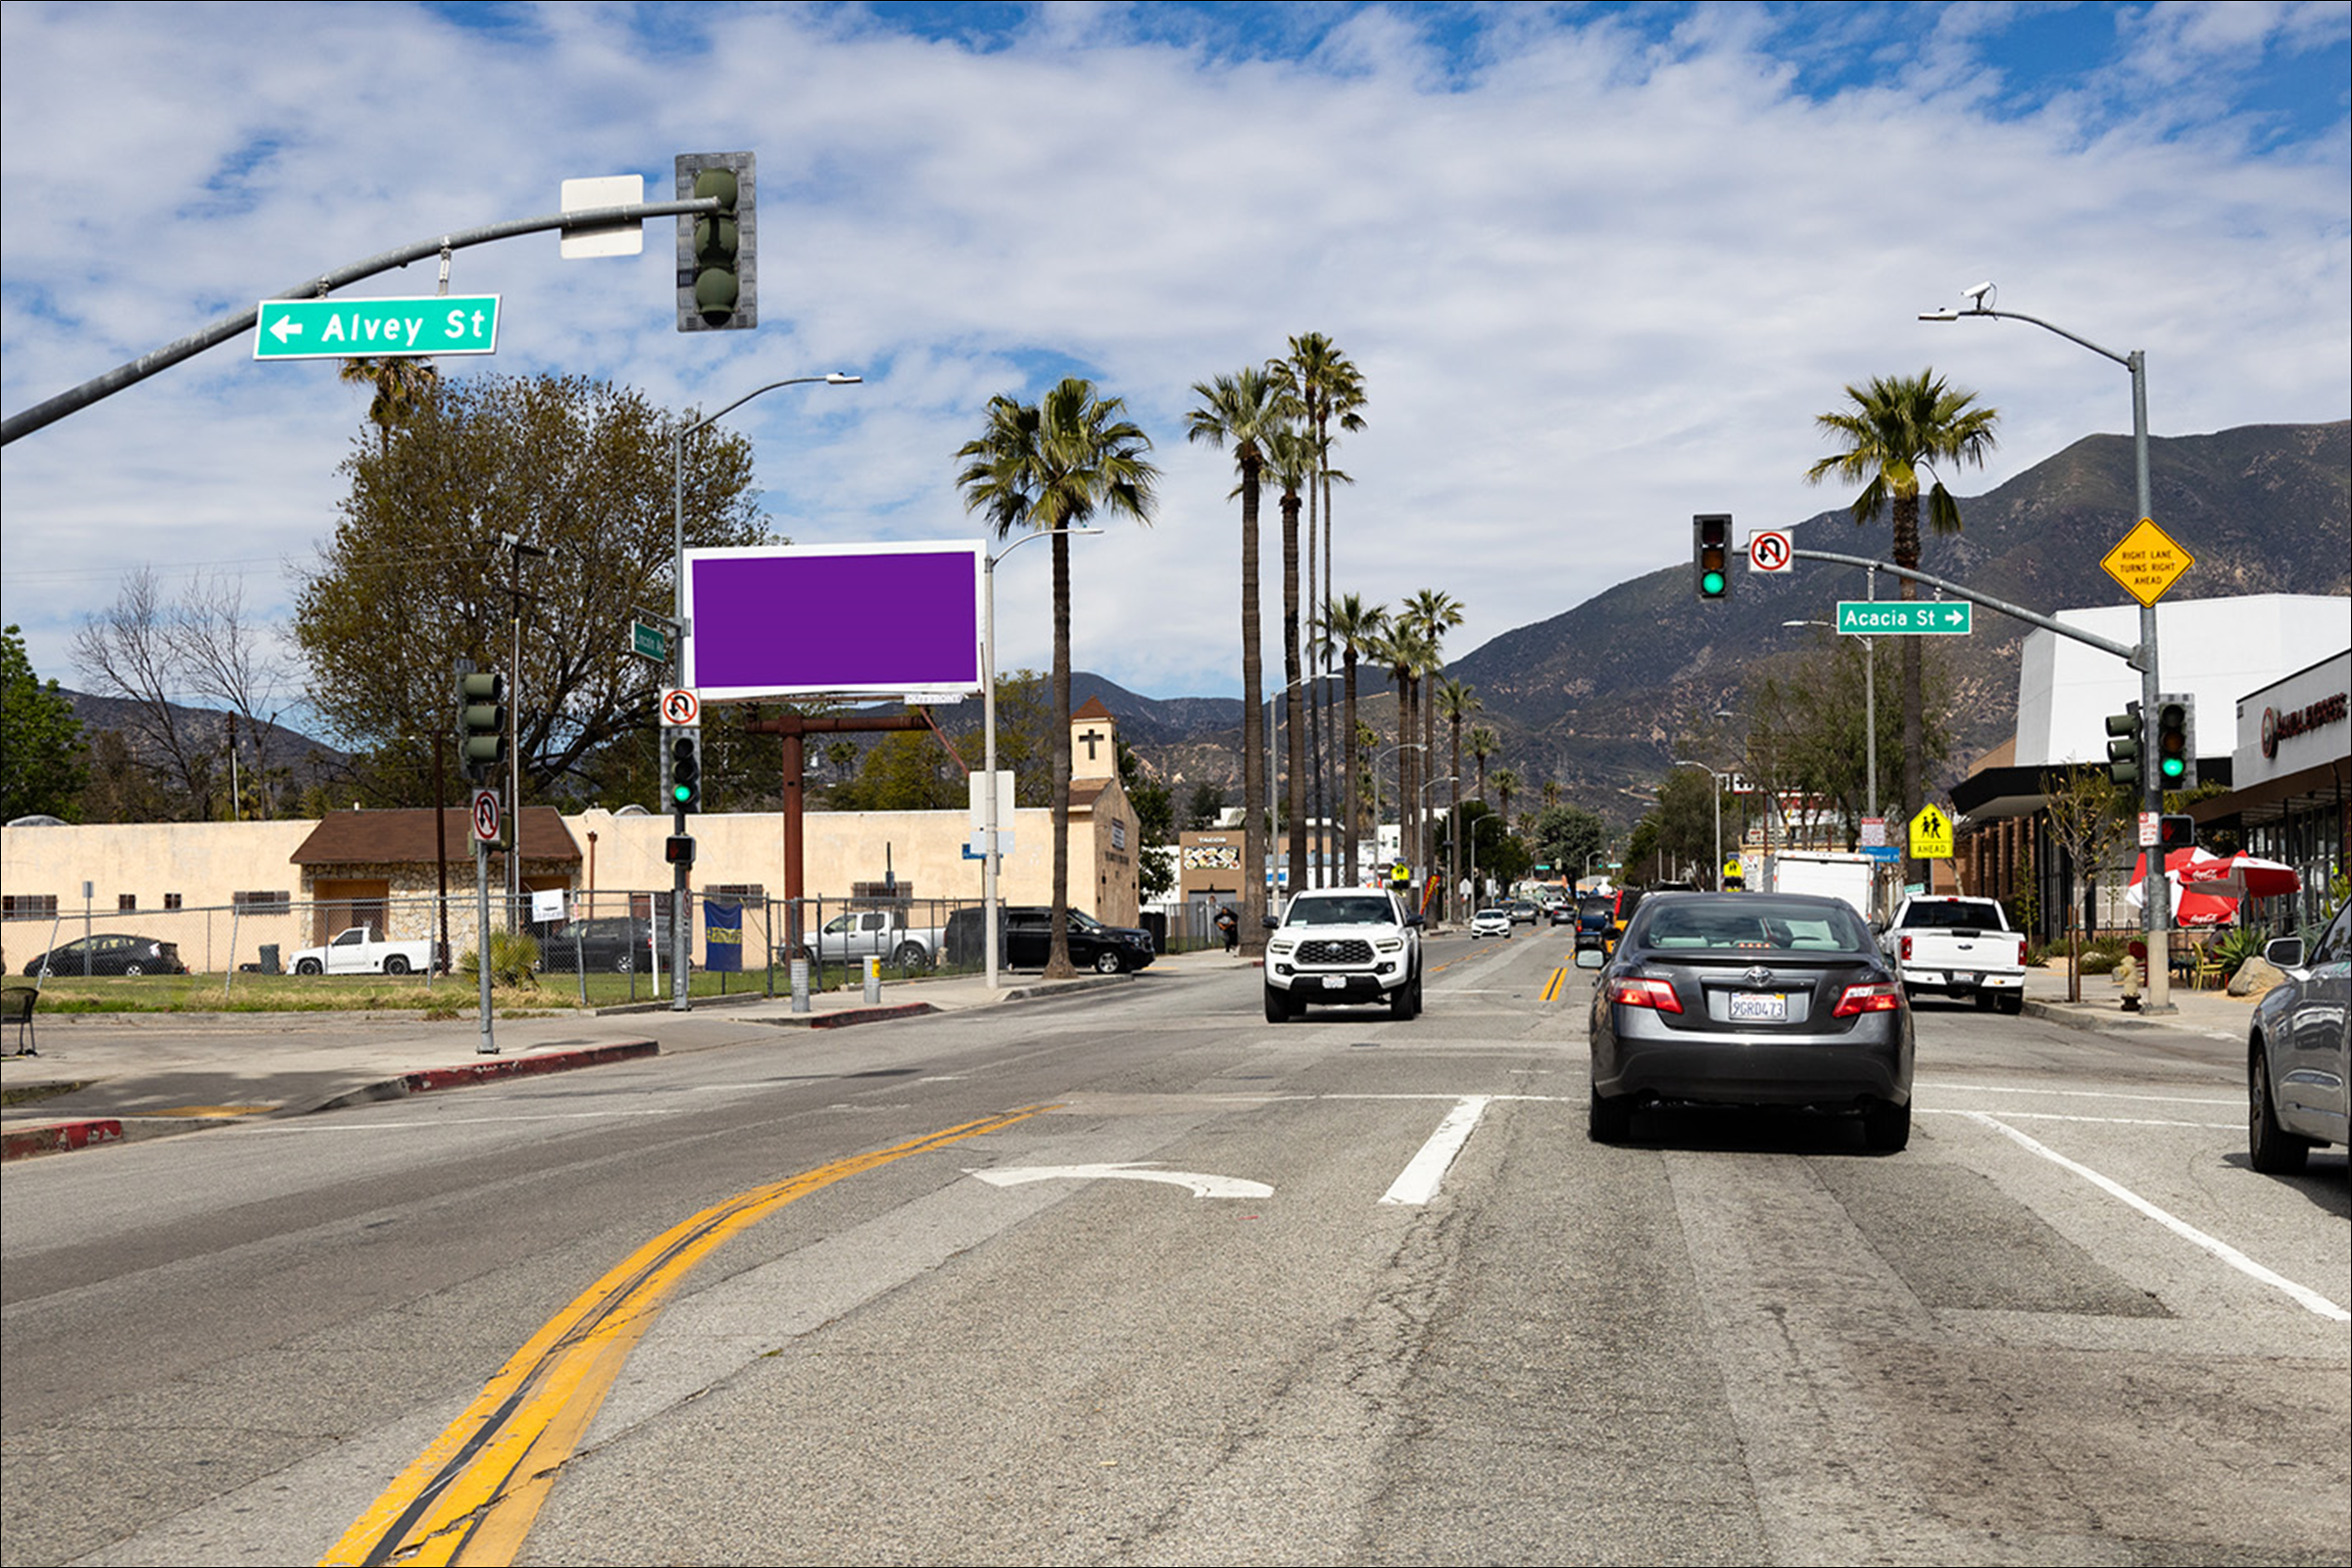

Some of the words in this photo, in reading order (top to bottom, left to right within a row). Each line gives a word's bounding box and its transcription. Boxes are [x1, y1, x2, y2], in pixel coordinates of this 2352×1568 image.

[321, 314, 423, 347] Alvey
[444, 310, 485, 338] St
[2122, 551, 2145, 560] RIGHT
[2150, 550, 2172, 560] LANE
[2120, 564, 2147, 572] TURNS
[2152, 563, 2175, 571] RIGHT
[2134, 575, 2163, 585] AHEAD
[1844, 610, 1907, 626] Acacia
[1917, 610, 1935, 626] St
[1917, 845, 1946, 855] AHEAD
[1733, 1001, 1784, 1016] 9GRD473
